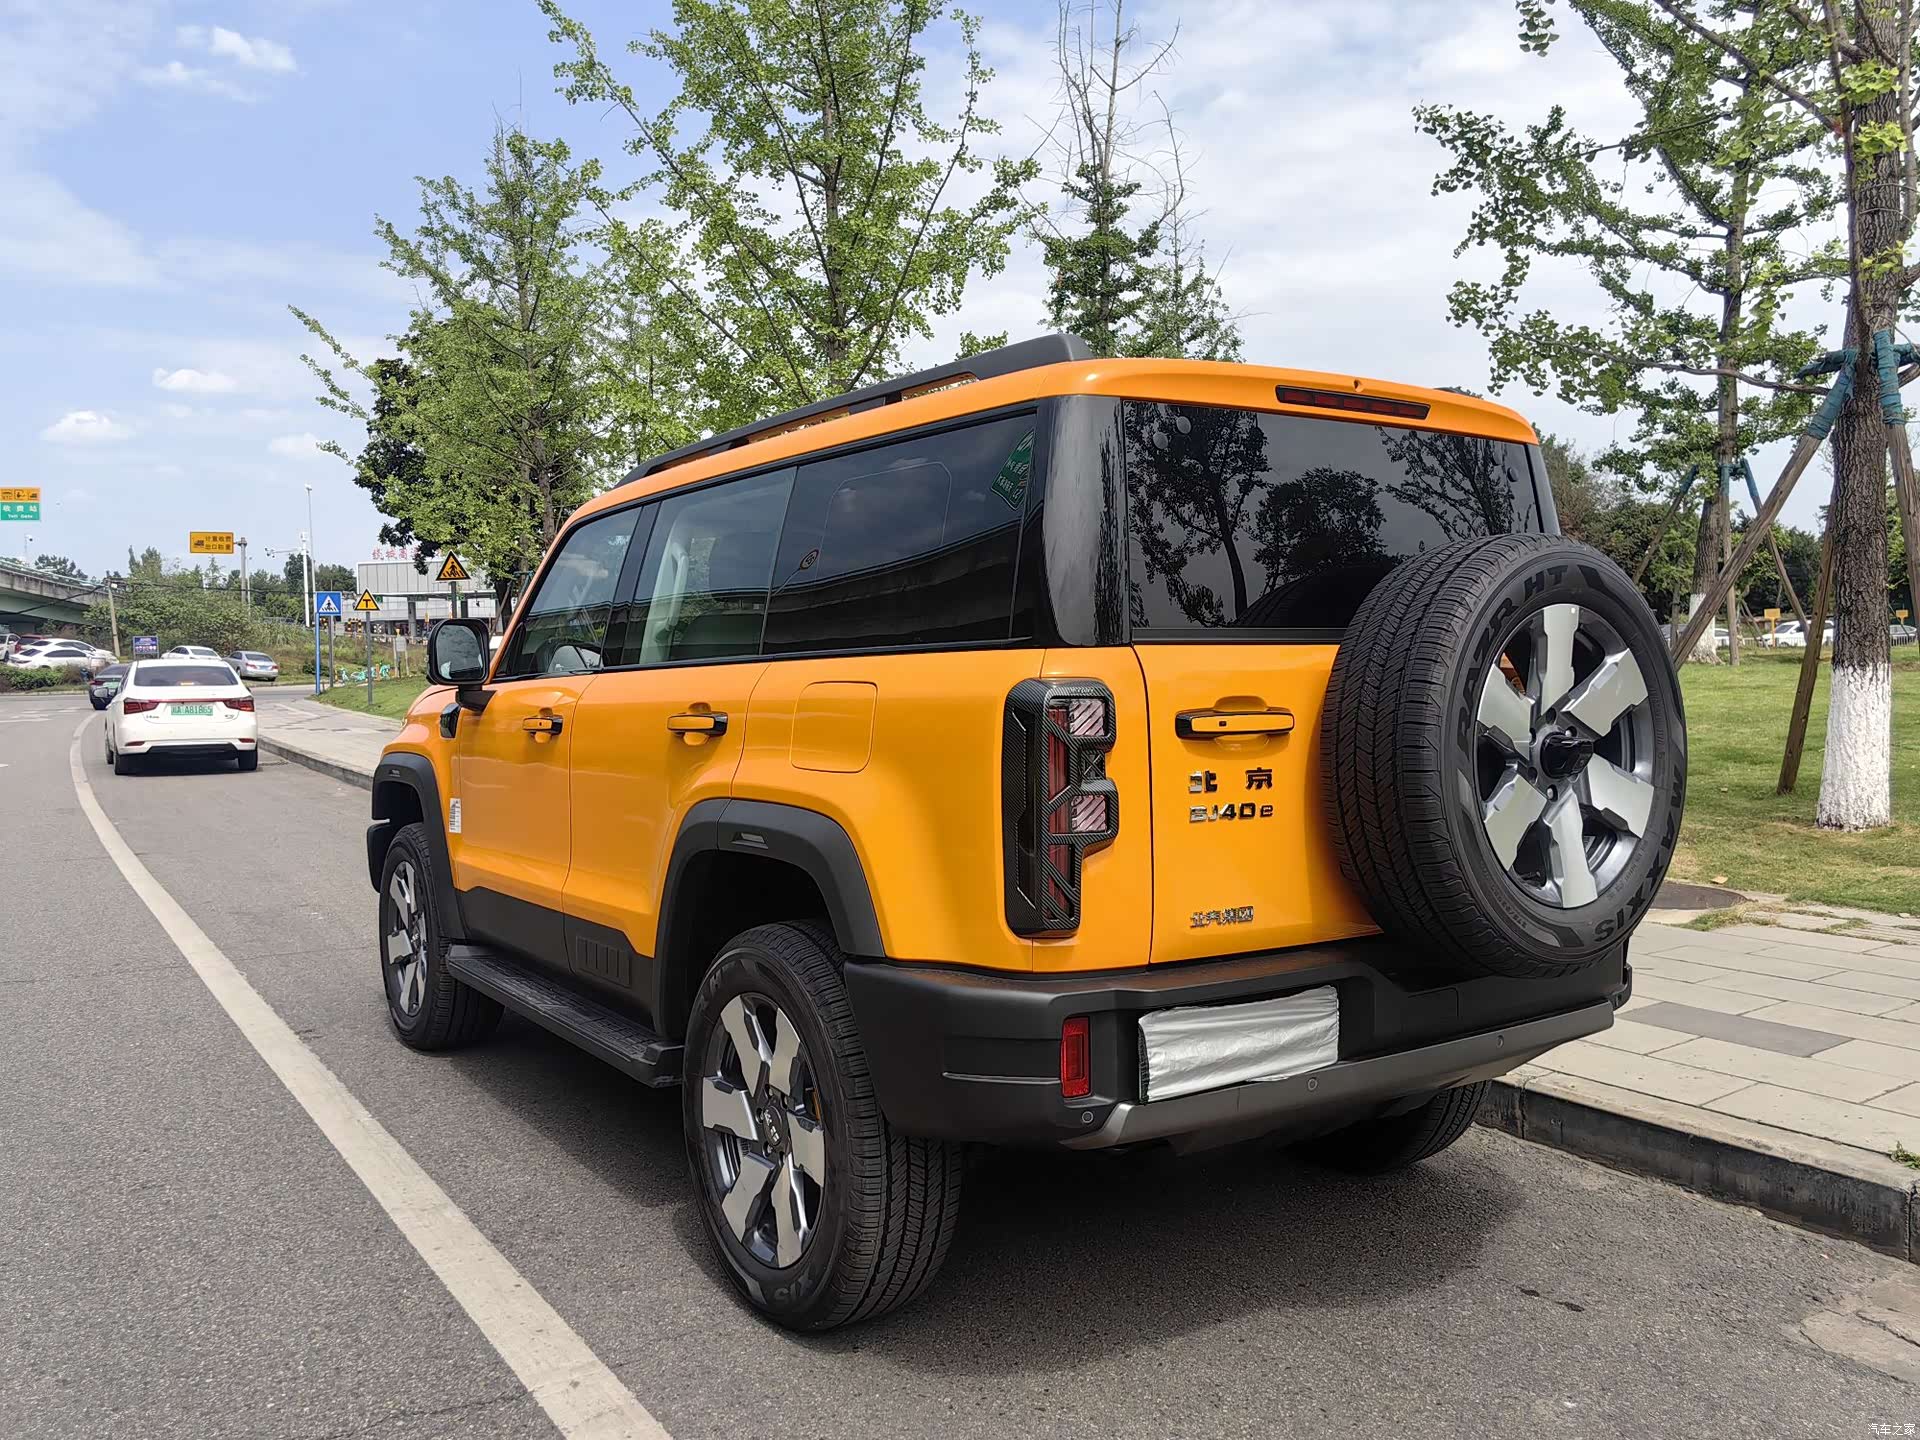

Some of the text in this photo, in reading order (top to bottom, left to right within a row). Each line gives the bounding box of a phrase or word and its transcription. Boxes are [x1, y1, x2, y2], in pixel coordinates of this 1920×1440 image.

[1457, 564, 1568, 760] RAZR HT
[1188, 767, 1273, 794] 北京
[1594, 765, 1683, 942] MAXXIS
[1190, 906, 1254, 929] 北汽集团
